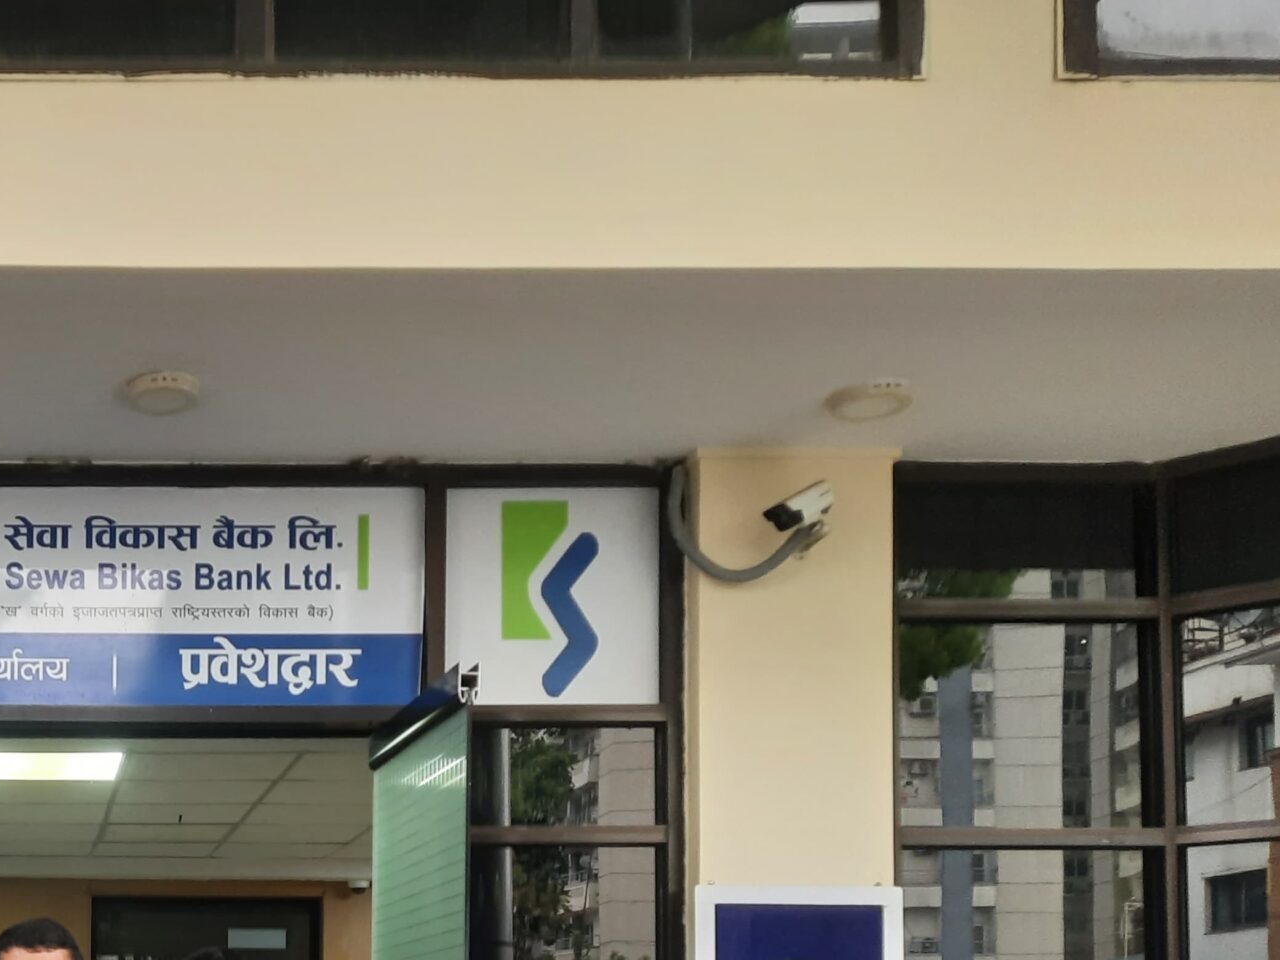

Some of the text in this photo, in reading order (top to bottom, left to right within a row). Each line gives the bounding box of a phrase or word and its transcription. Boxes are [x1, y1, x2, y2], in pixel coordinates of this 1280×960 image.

[4, 516, 72, 551] सेवा
[84, 515, 201, 551] विकास
[287, 515, 343, 550] लि.
[5, 562, 85, 590] Sewa
[97, 562, 182, 590] Bikas
[194, 563, 272, 590] Bank
[284, 563, 341, 590] Ltd.
[30, 602, 64, 618] वर्गको
[258, 603, 299, 619] विकास
[179, 636, 362, 696] प्रवेशद्वार
